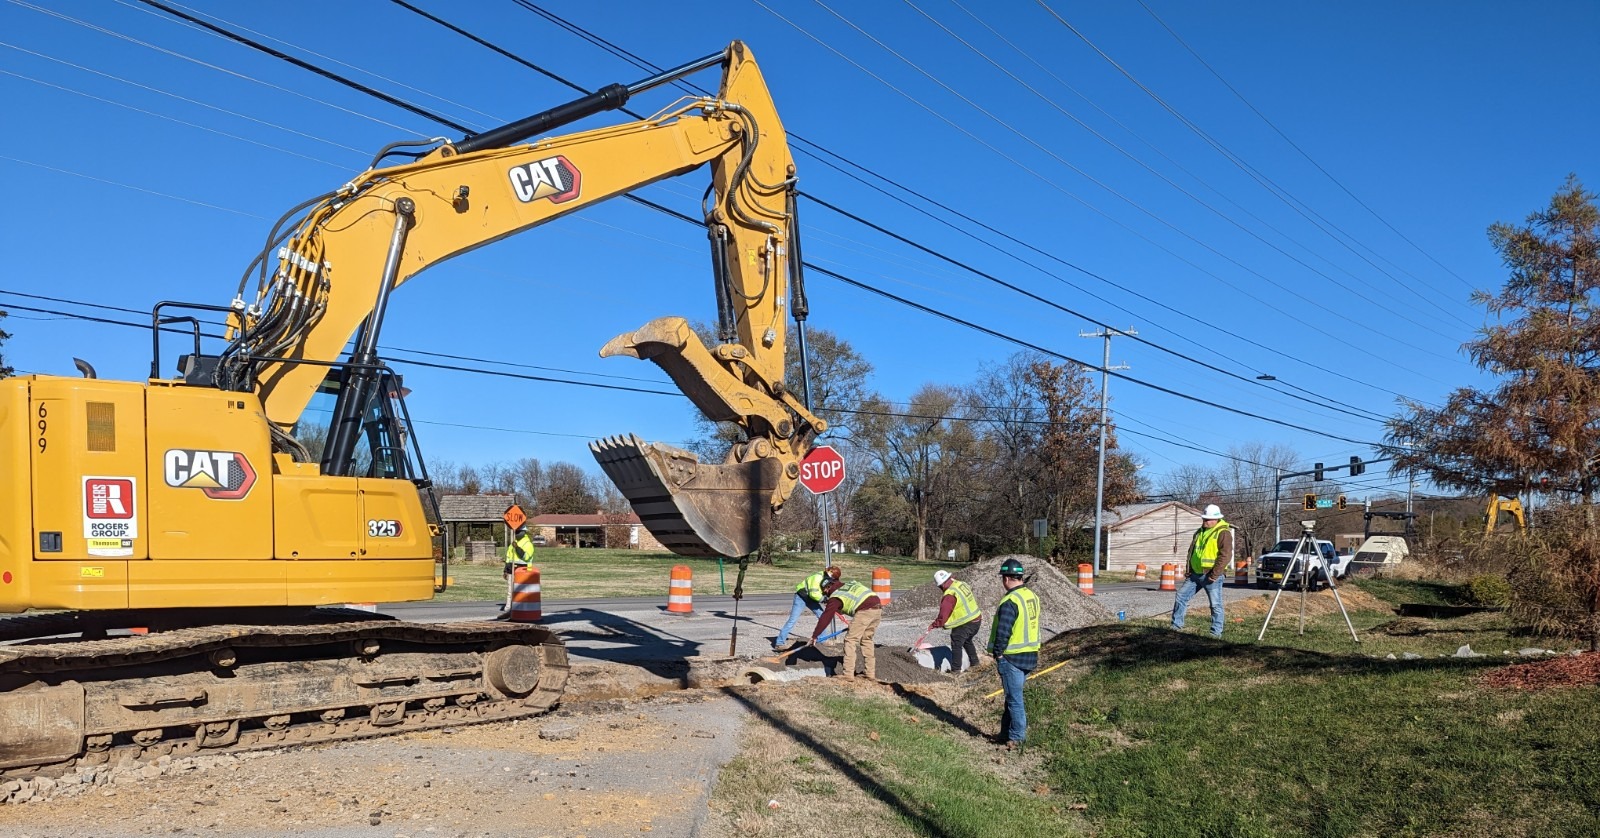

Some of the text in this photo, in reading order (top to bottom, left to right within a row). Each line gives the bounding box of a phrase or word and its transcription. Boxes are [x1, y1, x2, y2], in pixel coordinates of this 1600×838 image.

[509, 157, 565, 202] CAT
[38, 401, 47, 454] 699
[165, 449, 234, 488] CAT
[802, 460, 841, 480] STOP
[368, 520, 396, 537] 325
[506, 512, 523, 522] SLOW
